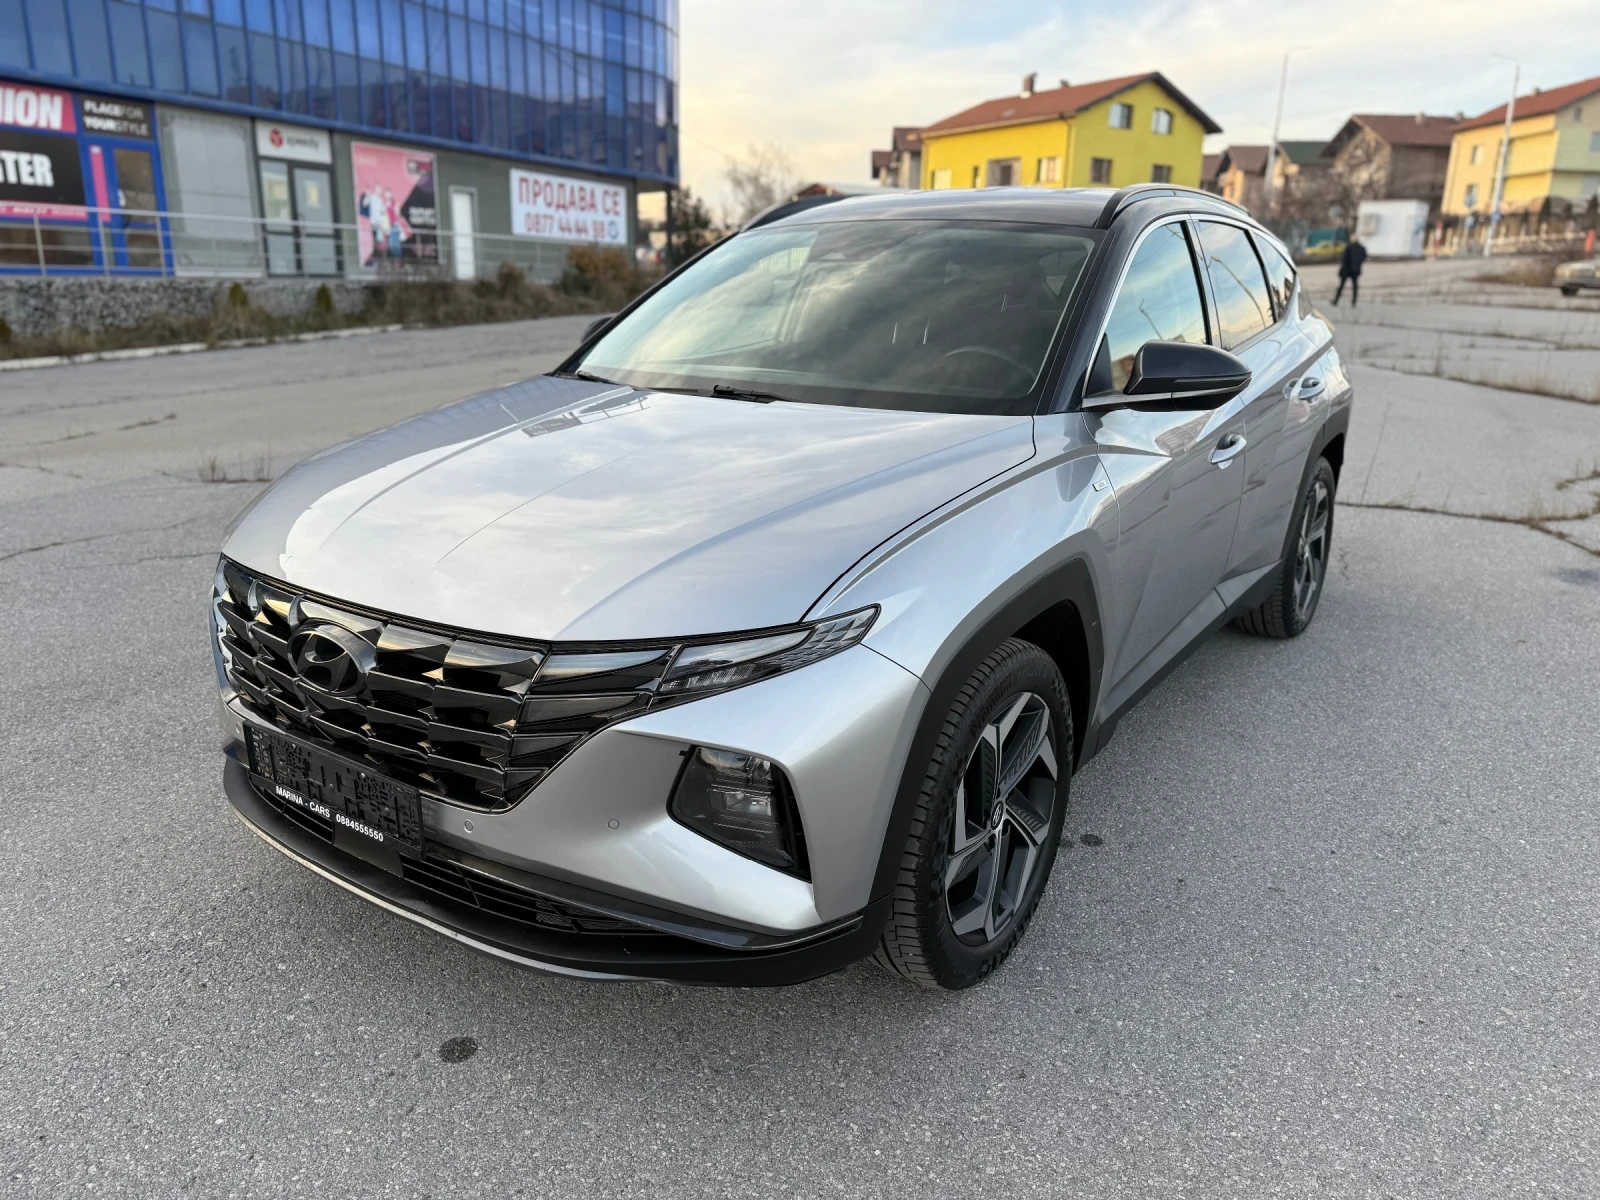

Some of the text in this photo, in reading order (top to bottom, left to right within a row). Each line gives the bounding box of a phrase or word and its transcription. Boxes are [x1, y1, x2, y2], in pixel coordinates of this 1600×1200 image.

[0, 86, 63, 131] ION
[0, 149, 54, 188] TER
[518, 176, 622, 217] ПРОДАВА СЕ
[275, 785, 304, 807] MARINA
[309, 801, 331, 818] CARS
[335, 813, 384, 842] 0884555550
